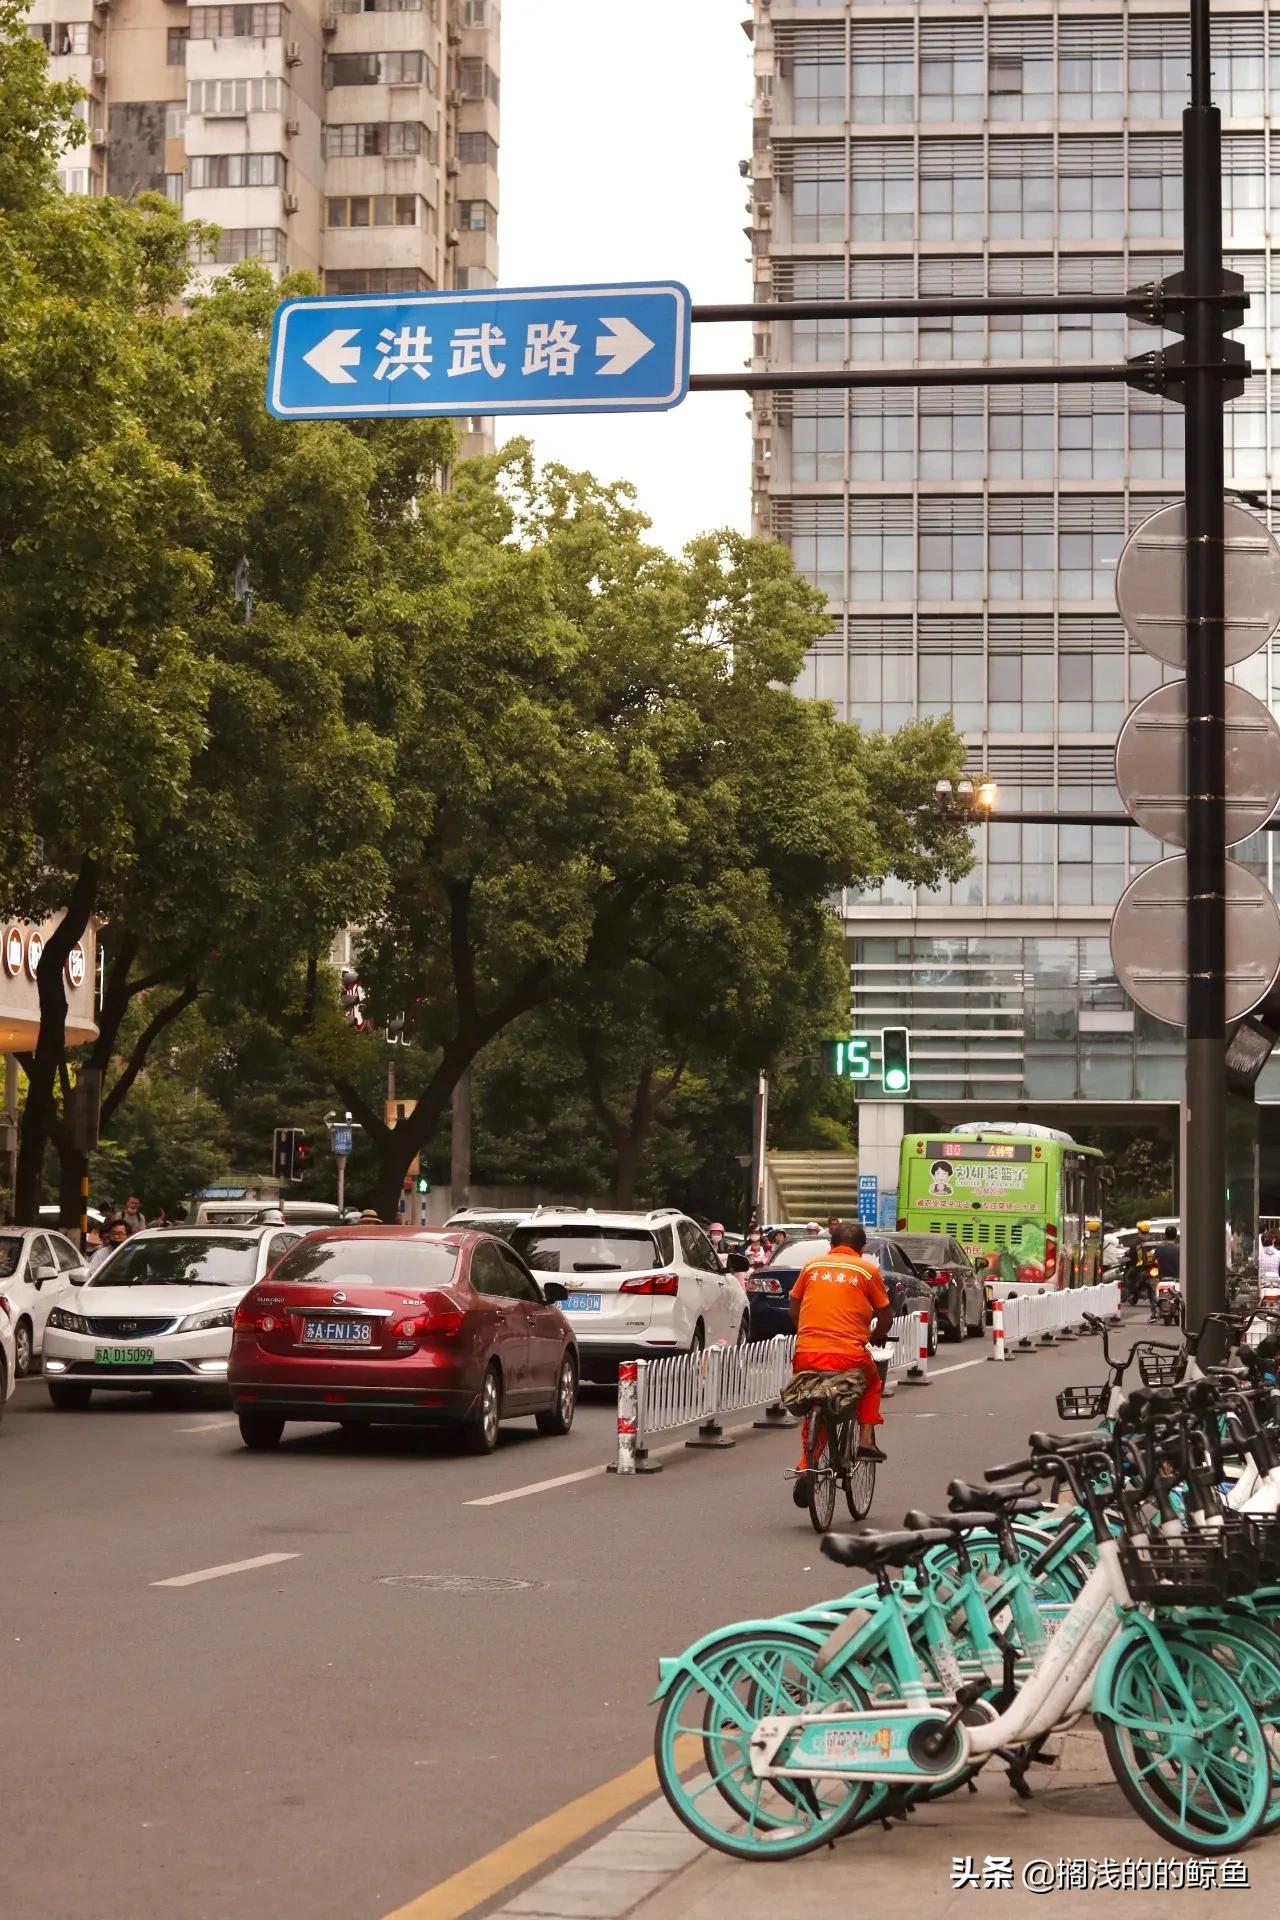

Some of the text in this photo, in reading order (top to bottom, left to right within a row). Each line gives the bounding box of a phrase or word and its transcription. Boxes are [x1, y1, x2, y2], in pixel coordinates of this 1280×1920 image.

[373, 320, 581, 381] 洪武路
[836, 1041, 870, 1078] 15
